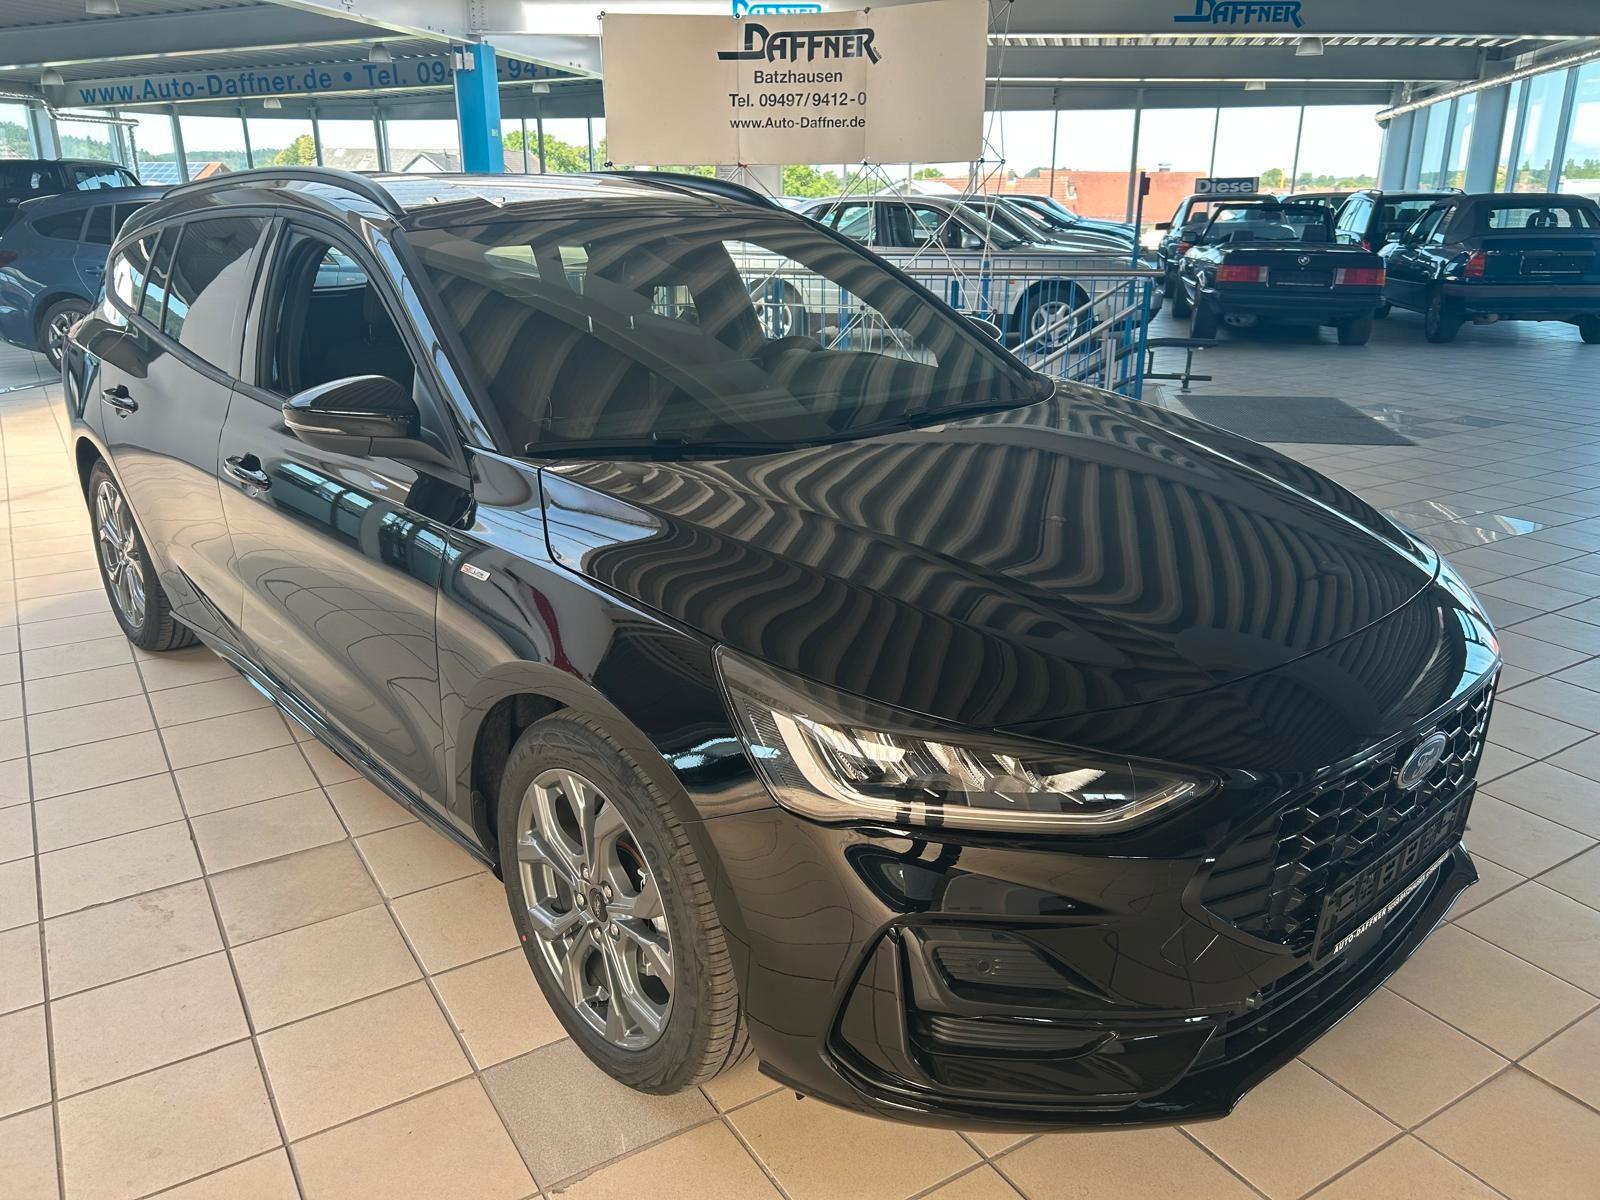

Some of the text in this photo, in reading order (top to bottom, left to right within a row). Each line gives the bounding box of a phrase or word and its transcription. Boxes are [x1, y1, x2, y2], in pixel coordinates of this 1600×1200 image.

[1173, 0, 1302, 28] DAFFNER
[717, 23, 879, 64] DAFFNER
[79, 67, 333, 104] www.Auto-Daffner.de
[362, 64, 407, 86] Tel.
[754, 71, 843, 84] Batzhausen
[729, 93, 754, 107] Tel.
[729, 116, 866, 129] www.Auto-Daffner.de
[1197, 178, 1258, 193] Diesel
